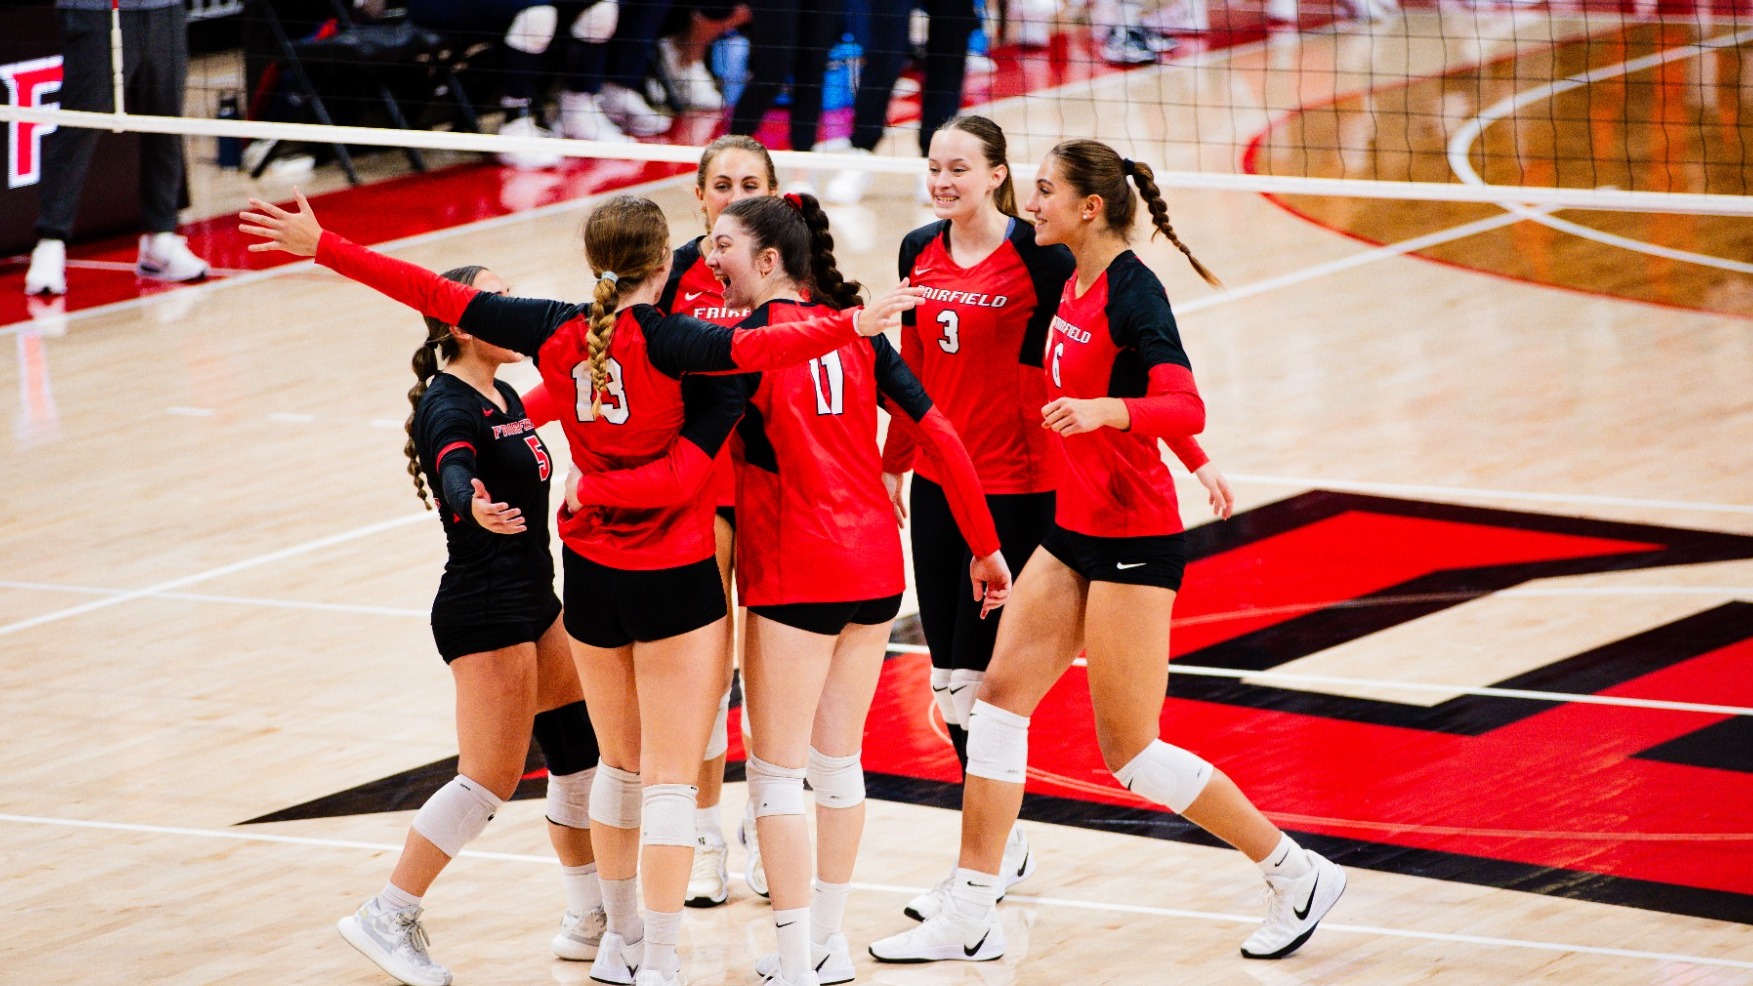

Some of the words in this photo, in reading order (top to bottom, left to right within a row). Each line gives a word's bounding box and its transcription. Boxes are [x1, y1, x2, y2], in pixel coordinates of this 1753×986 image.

[936, 309, 959, 354] 3
[808, 349, 844, 415] 11
[1052, 342, 1064, 389] 6
[571, 356, 630, 425] 13
[523, 434, 551, 482] 5
